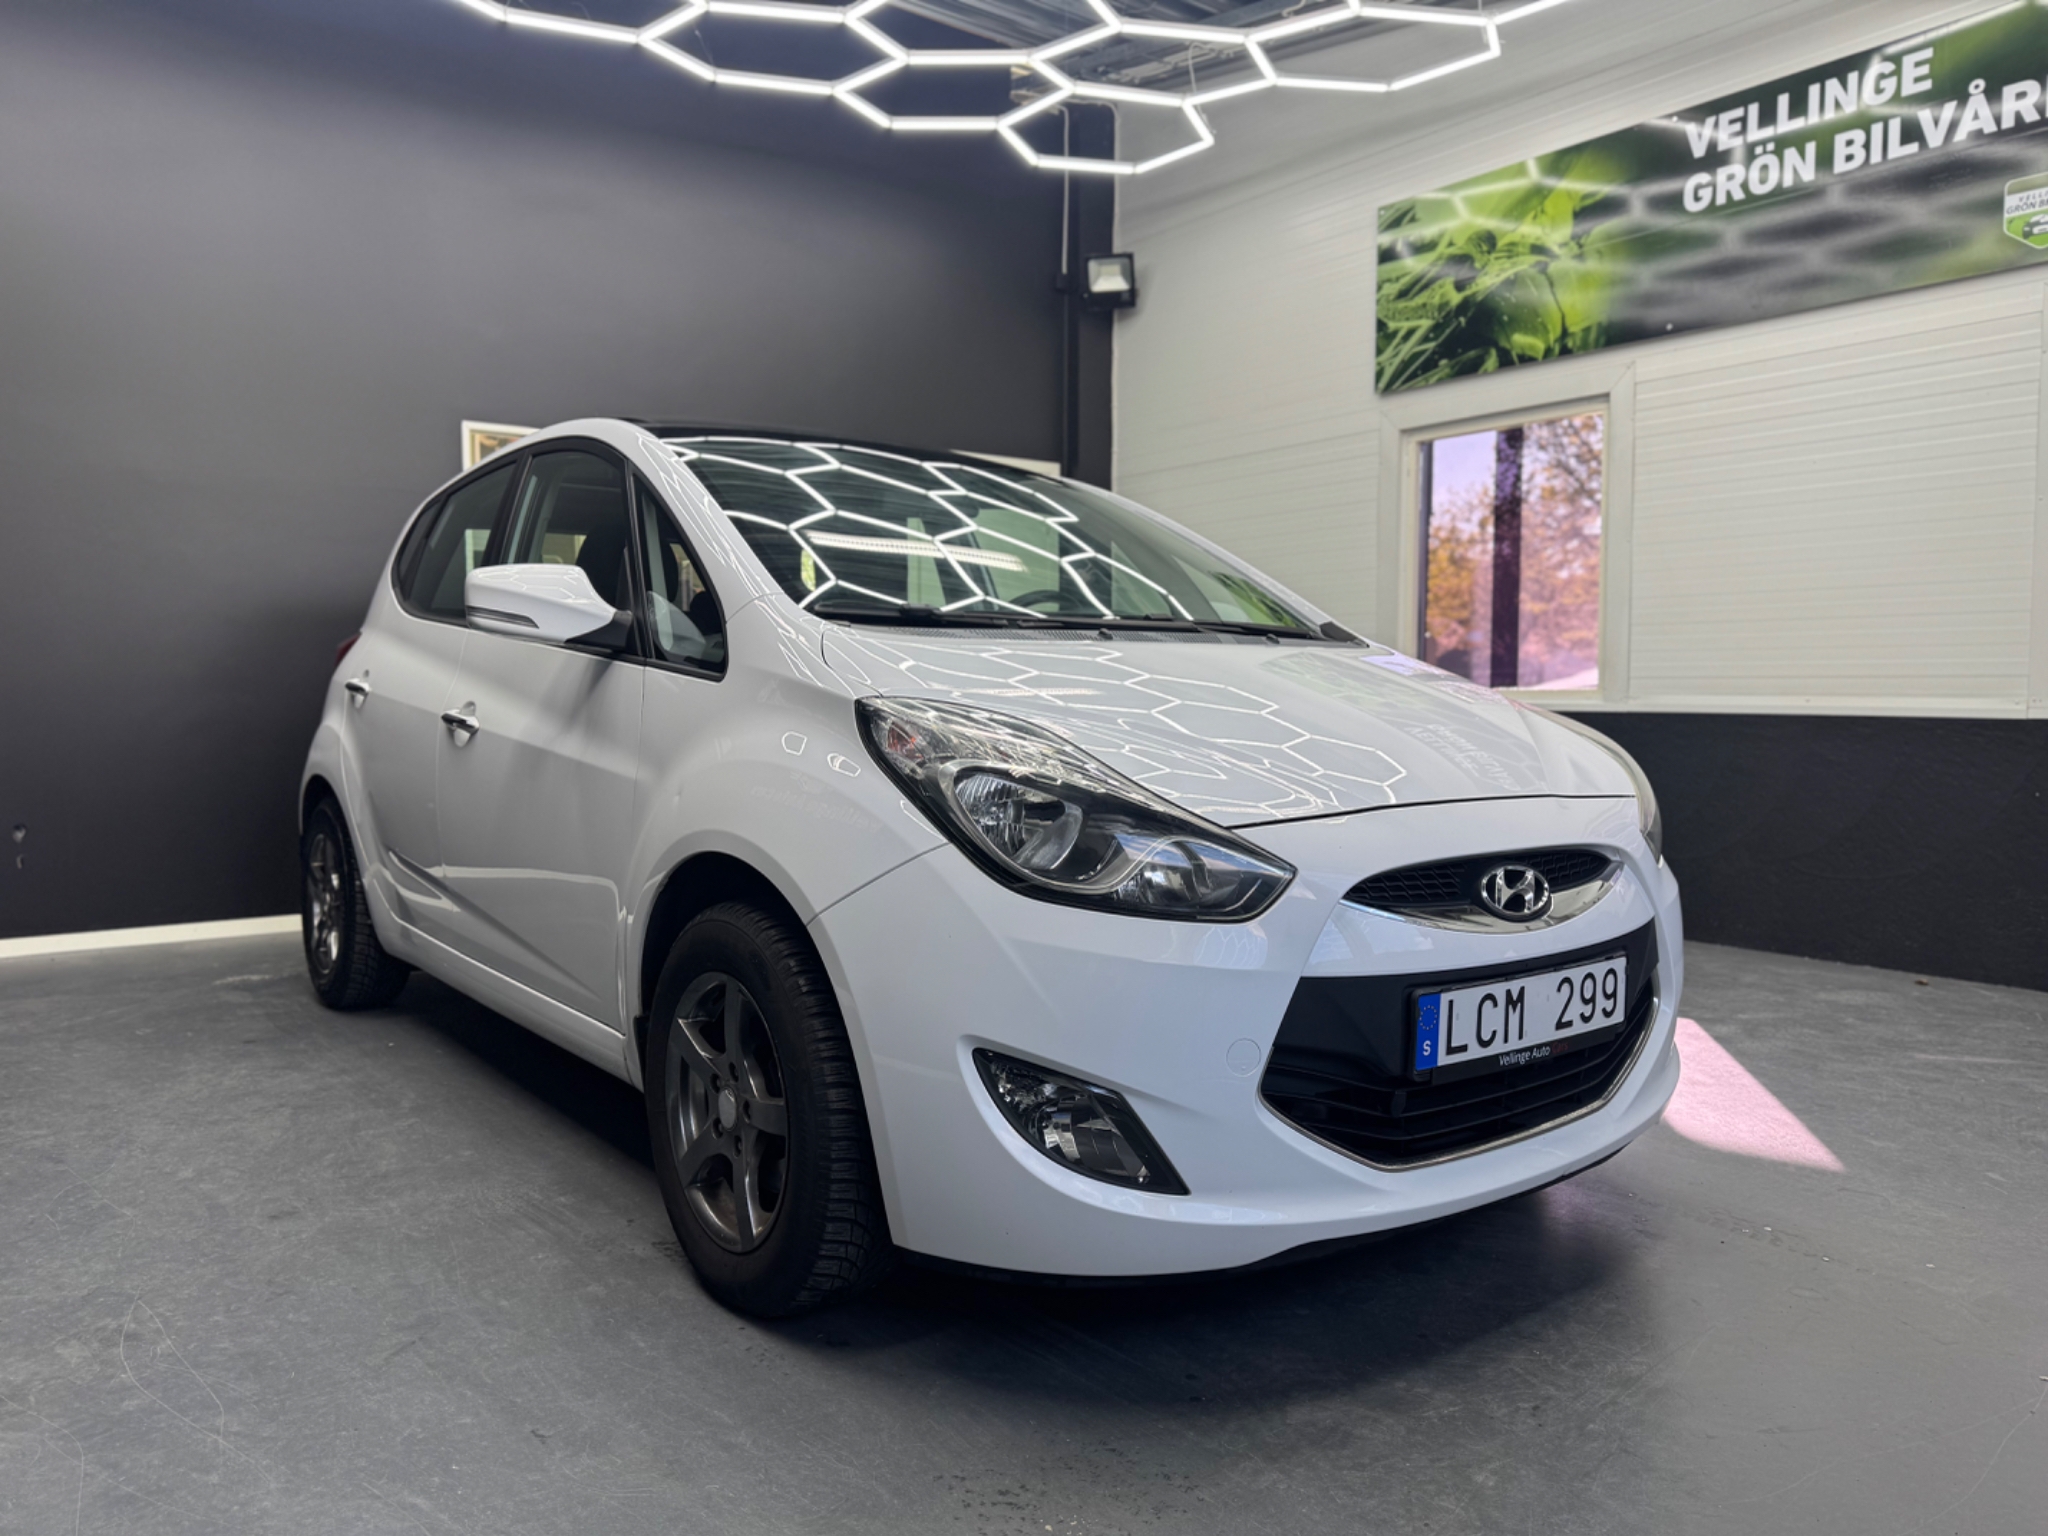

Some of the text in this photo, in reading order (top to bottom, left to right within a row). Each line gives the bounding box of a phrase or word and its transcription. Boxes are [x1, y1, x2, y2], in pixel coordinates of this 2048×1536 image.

[1683, 74, 2048, 213] GRÖN BILVÅR
[1685, 47, 1934, 159] VELLINGE
[1423, 1040, 1431, 1056] S
[1445, 967, 1618, 1056] LCM 299
[1499, 1051, 1530, 1066] Vellinge
[1531, 1045, 1551, 1060] Auto
